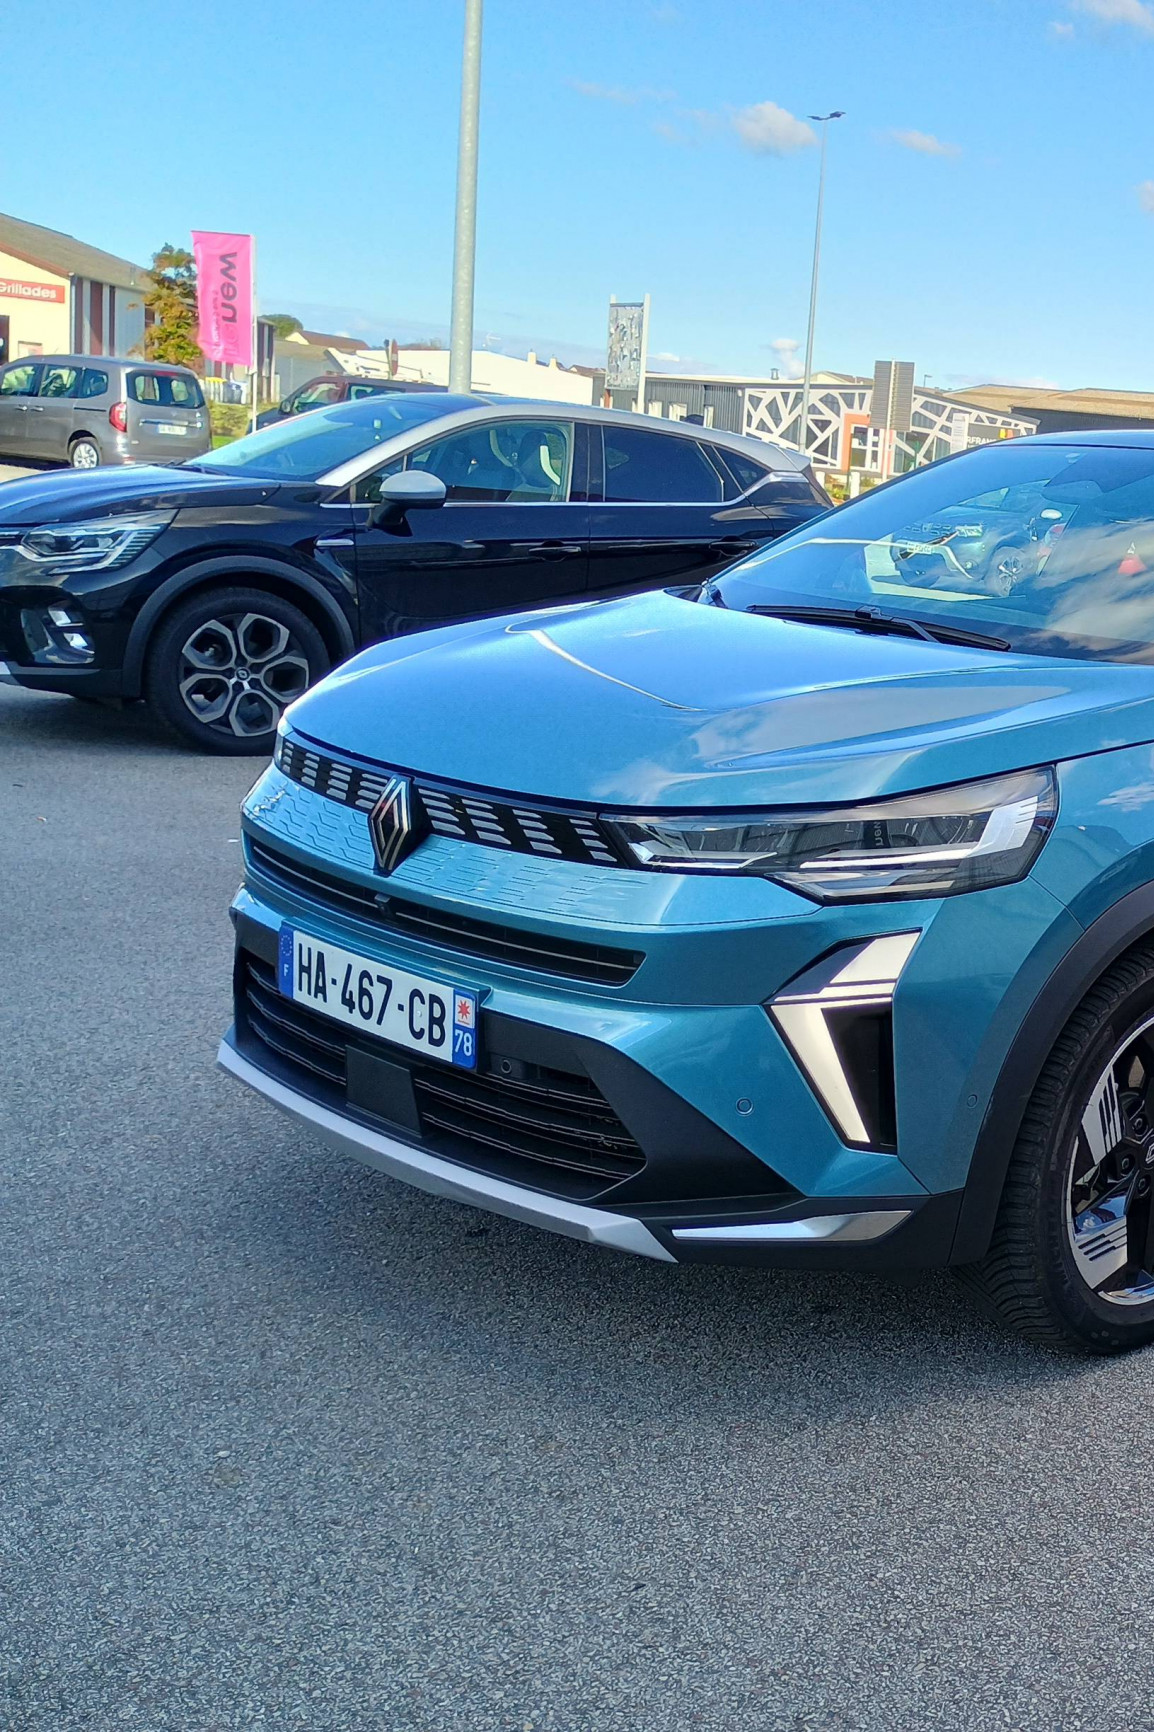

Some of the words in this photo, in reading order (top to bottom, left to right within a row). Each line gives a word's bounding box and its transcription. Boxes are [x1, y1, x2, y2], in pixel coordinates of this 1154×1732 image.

[0, 281, 57, 299] Grillades
[283, 963, 290, 977] F
[298, 942, 446, 1048] HA-467-CB
[454, 1028, 473, 1057] 78
